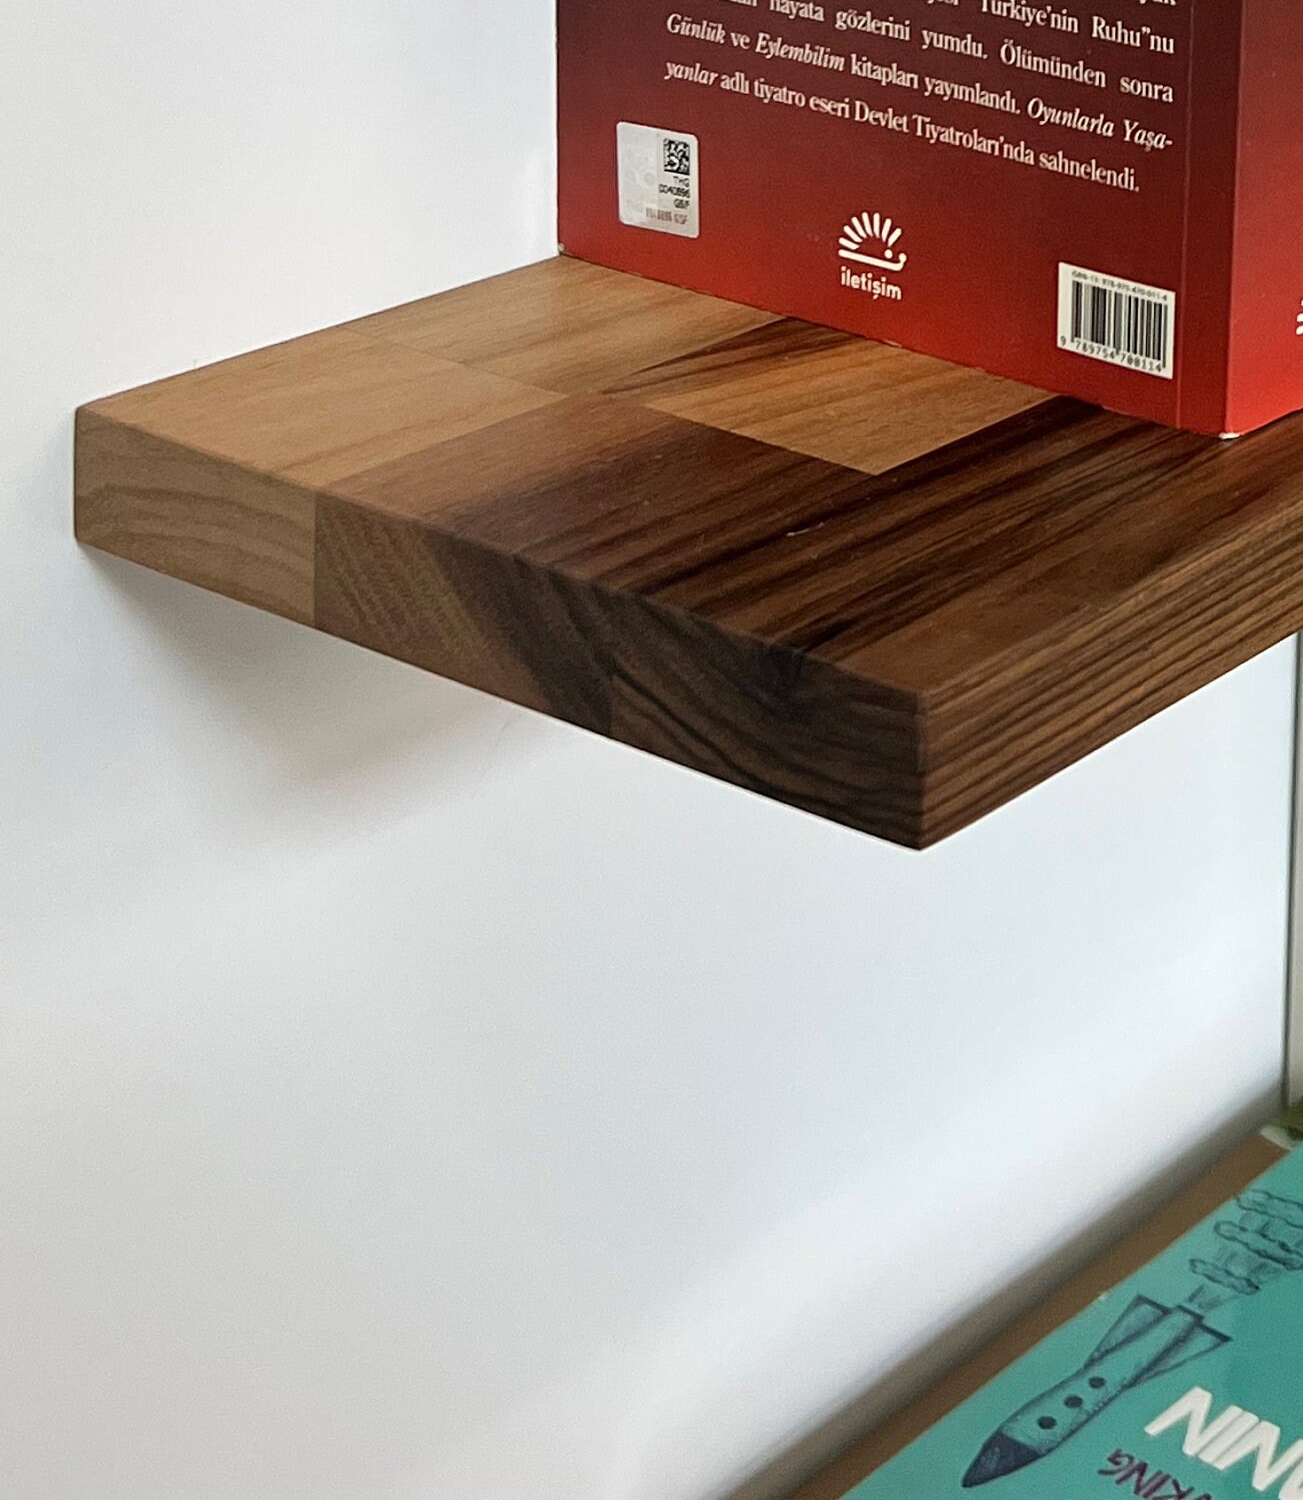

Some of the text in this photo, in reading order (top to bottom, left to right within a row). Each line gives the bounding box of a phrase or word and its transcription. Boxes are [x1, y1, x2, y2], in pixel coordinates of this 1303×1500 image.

[666, 13, 725, 44] Günlük
[729, 31, 750, 49] ve
[754, 32, 845, 71] Eylembilim
[850, 52, 918, 89] kitapları
[923, 76, 1021, 114] yayımlandı.
[1027, 97, 1114, 137] Oyunlarla
[834, 8, 910, 41] gözlerini
[921, 29, 987, 59] yumdu.
[999, 38, 1106, 88] Ölümünden
[1119, 76, 1173, 103] sonra
[663, 61, 718, 85] yanlar
[720, 71, 749, 94] adlı
[753, 77, 805, 107] tiyatro
[808, 95, 850, 118] eseri
[853, 99, 909, 132] Devlet
[1038, 149, 1139, 192] sahnelendi.
[840, 266, 903, 299] iletişim
